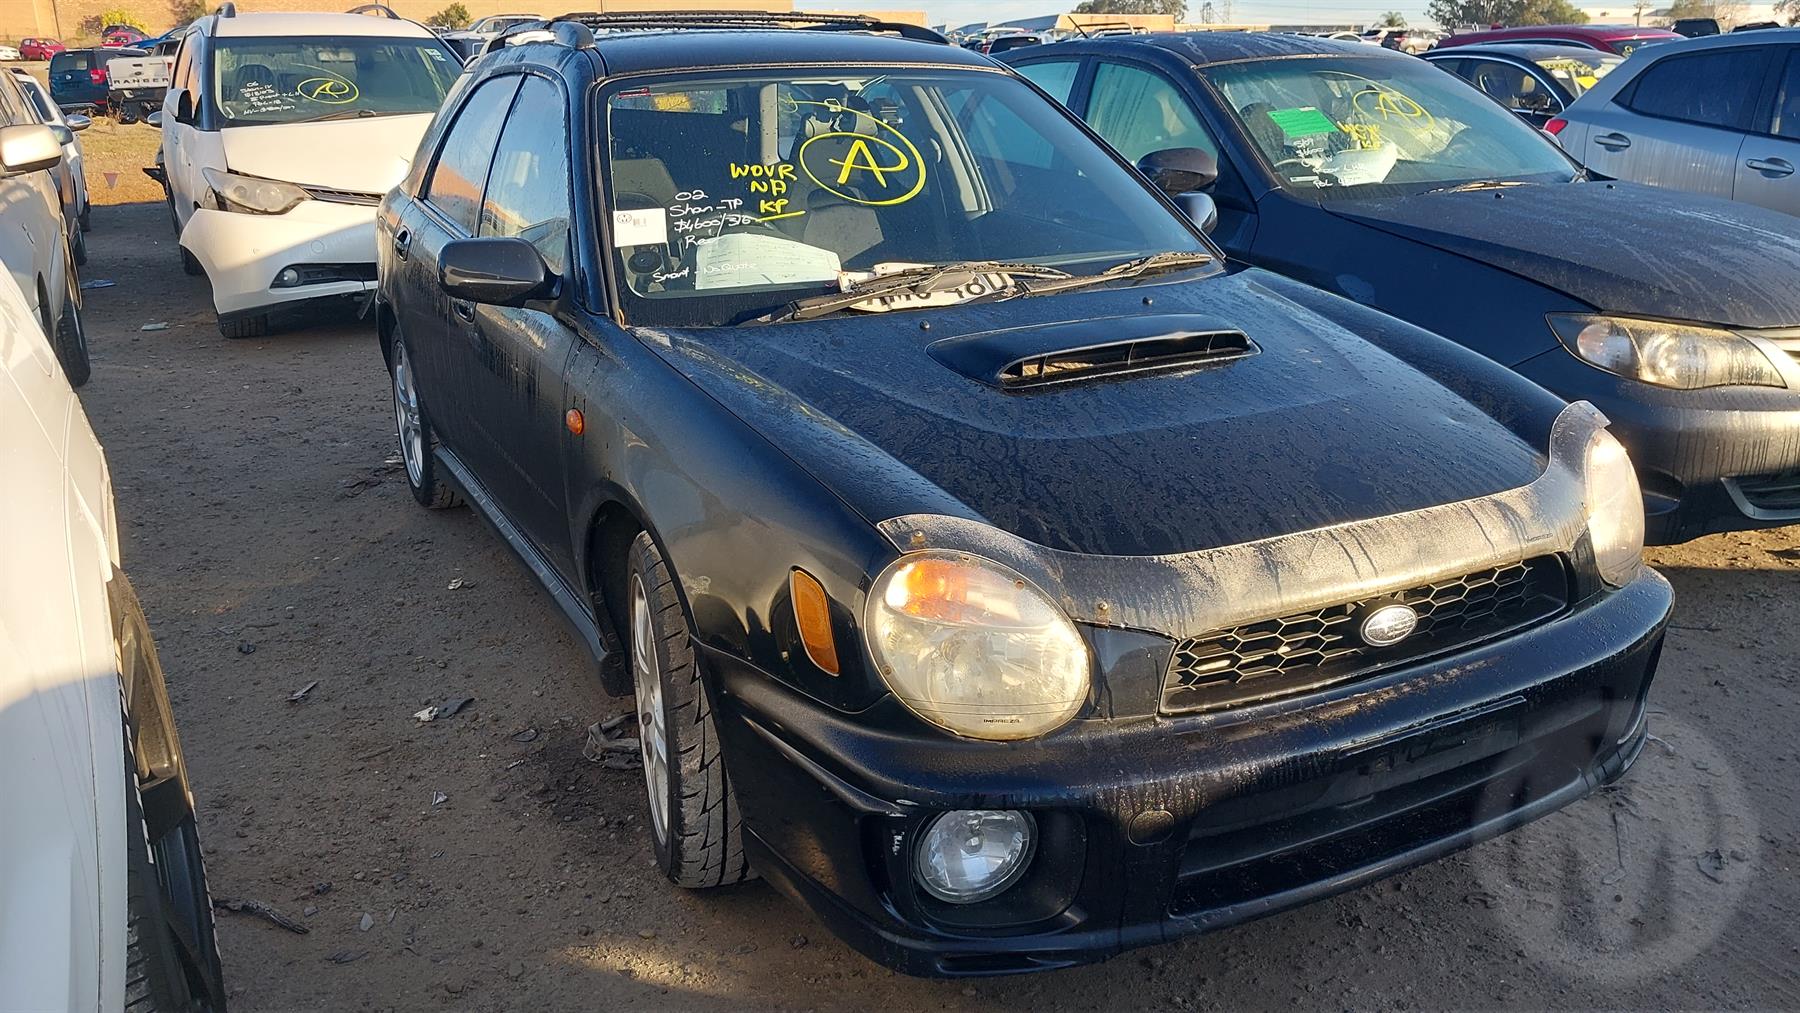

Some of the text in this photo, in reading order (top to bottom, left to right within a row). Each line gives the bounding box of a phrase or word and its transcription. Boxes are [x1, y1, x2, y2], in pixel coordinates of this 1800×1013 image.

[113, 77, 169, 85] RANGER
[730, 162, 798, 181] WOVR
[674, 189, 709, 201] 02
[750, 178, 787, 196] NA
[760, 198, 789, 214] KP
[652, 266, 690, 283] Smart
